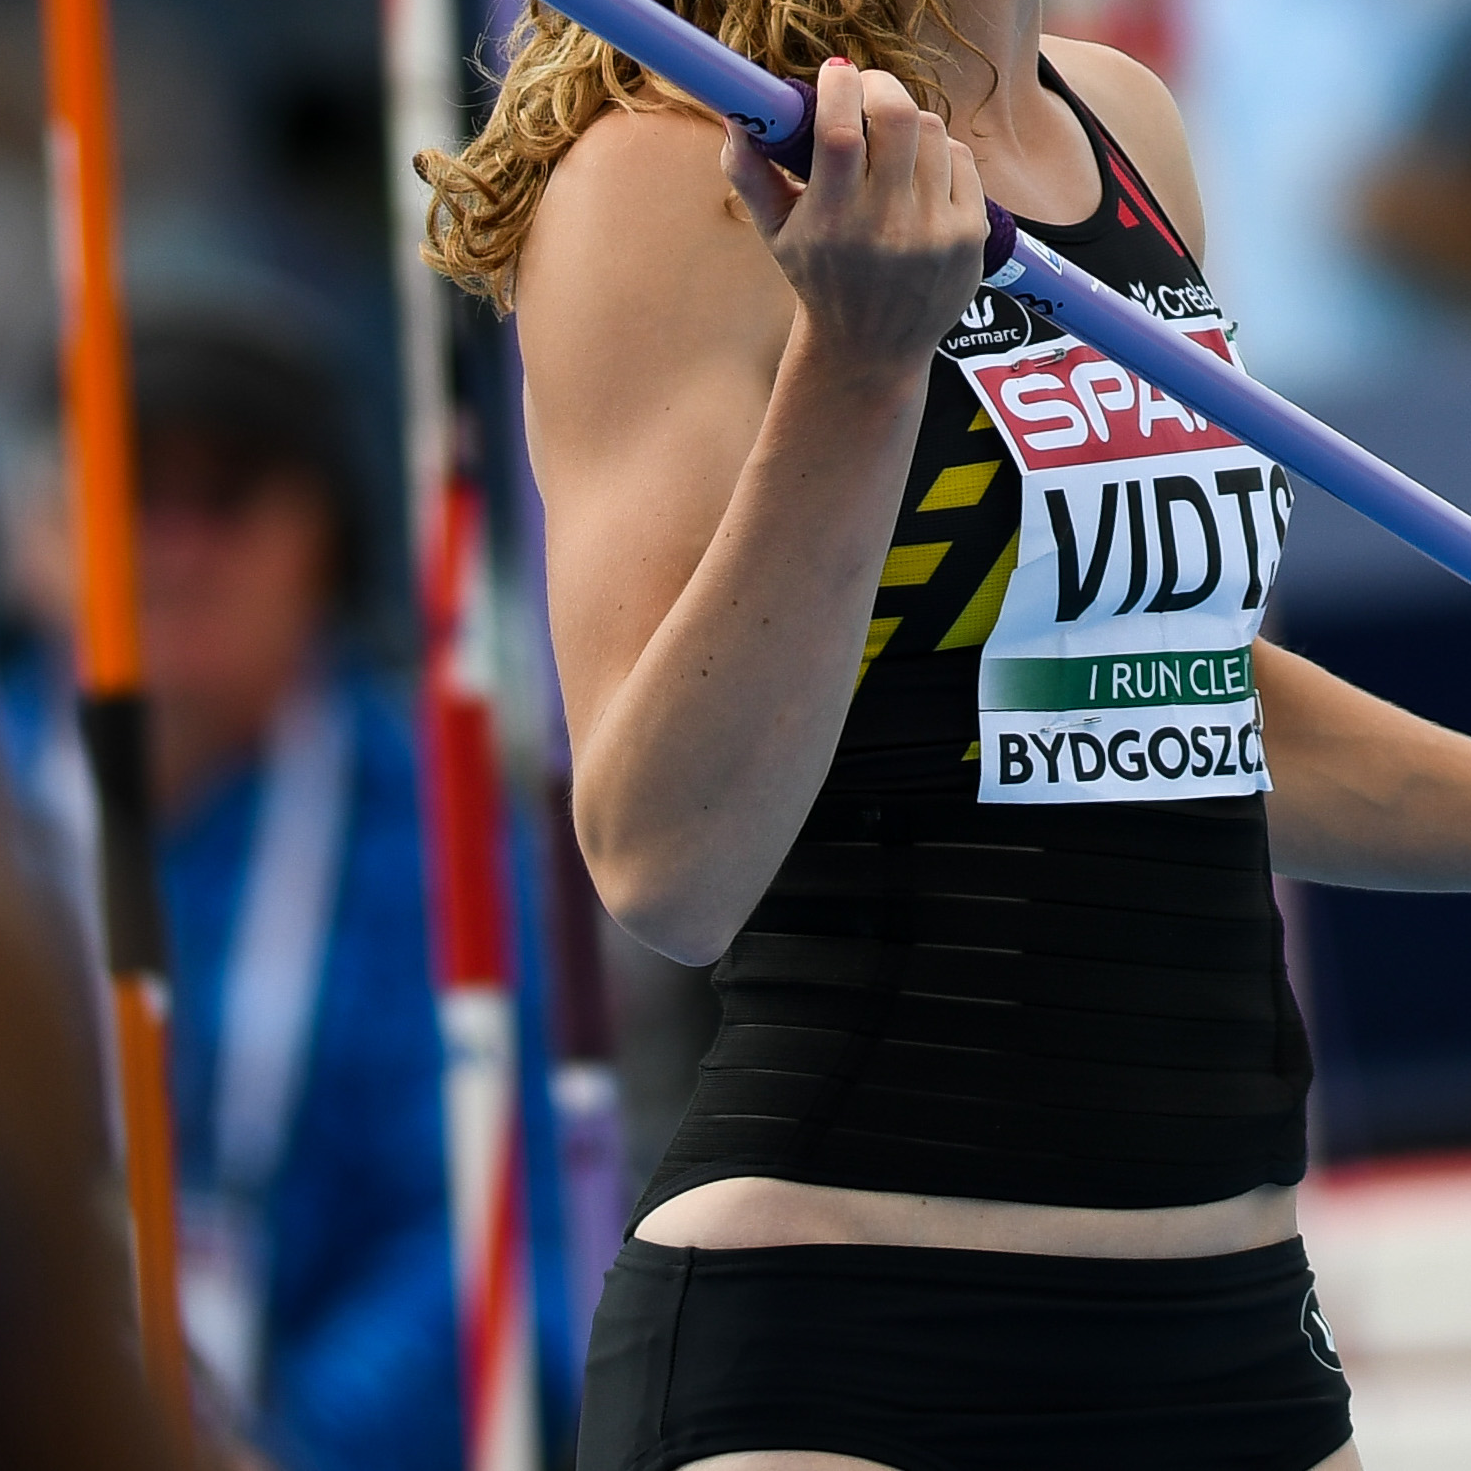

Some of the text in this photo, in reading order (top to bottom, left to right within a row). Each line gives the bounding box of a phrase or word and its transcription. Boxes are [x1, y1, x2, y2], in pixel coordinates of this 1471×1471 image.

[946, 327, 1021, 350] vermarc
[1000, 360, 1209, 451] SPA
[1089, 652, 1250, 701] I RUN CLE
